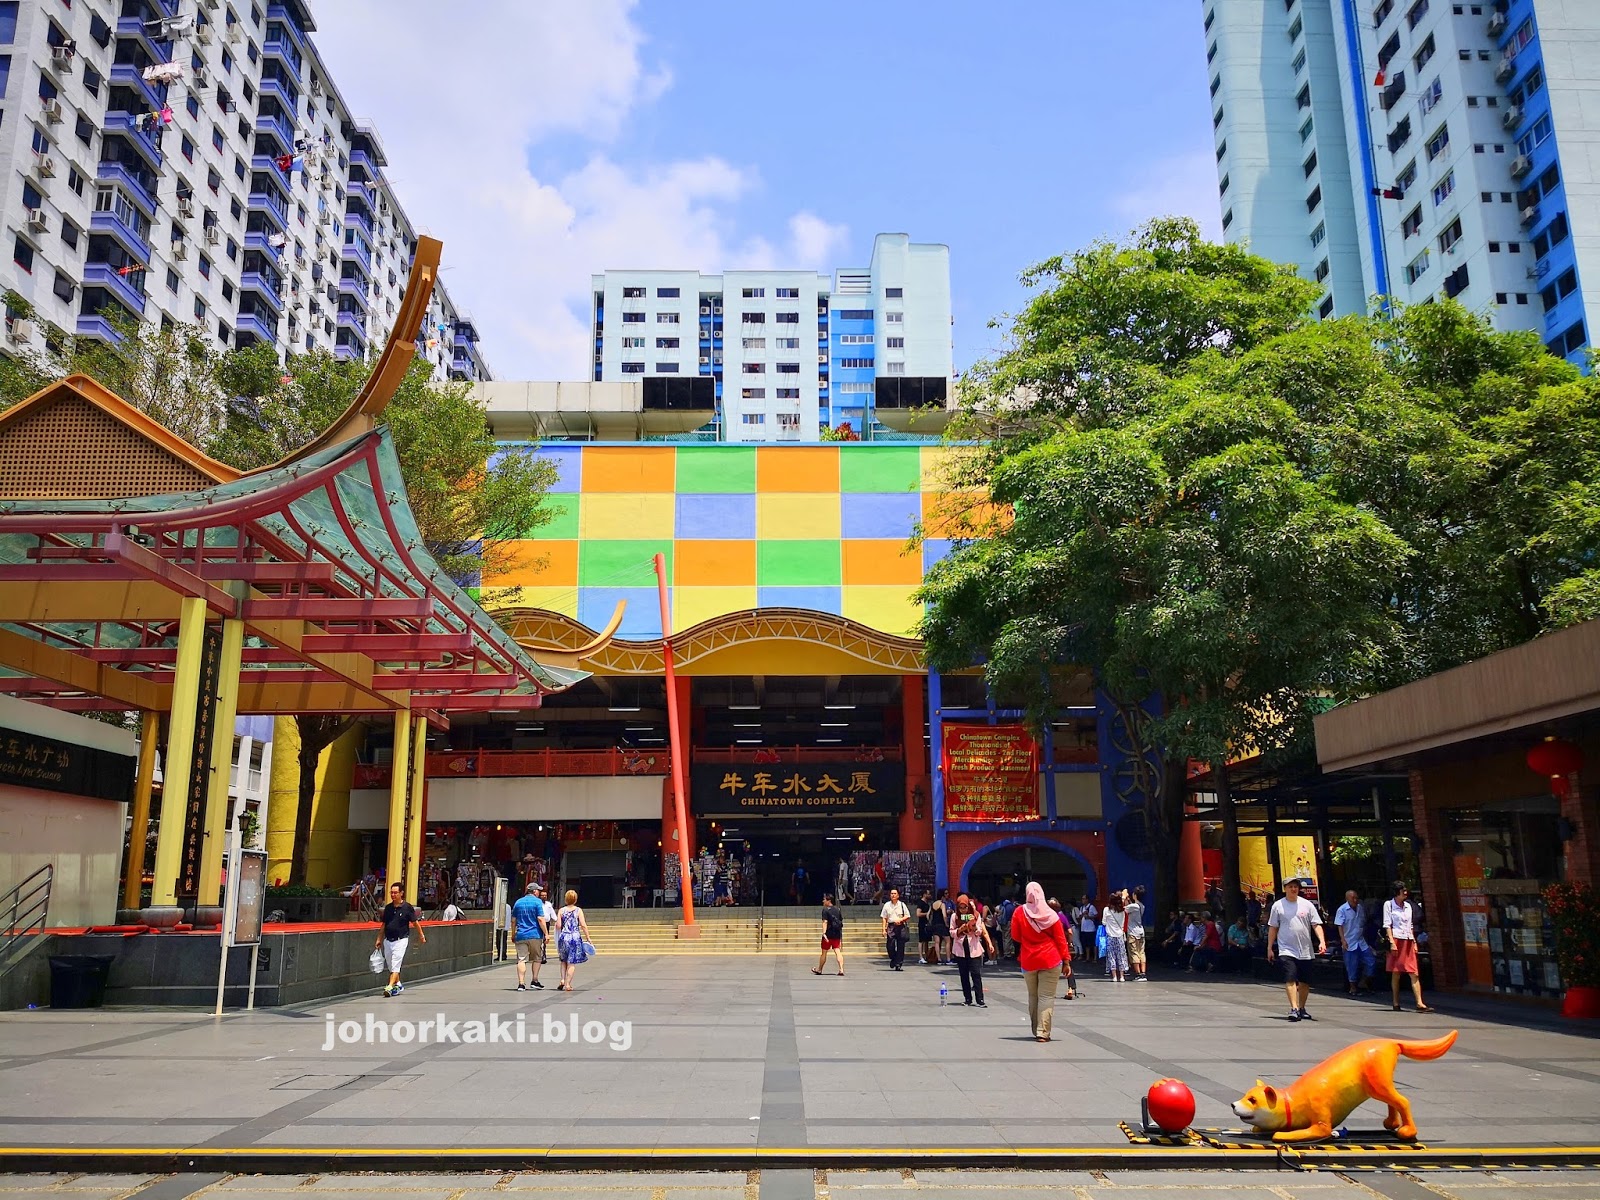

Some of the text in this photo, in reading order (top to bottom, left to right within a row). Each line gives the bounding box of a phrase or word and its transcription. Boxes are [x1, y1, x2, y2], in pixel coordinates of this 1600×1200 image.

[994, 734, 1020, 742] Complex
[719, 771, 877, 797] 牛车水大厦
[741, 797, 855, 806] CHINATOWN COMPLEX
